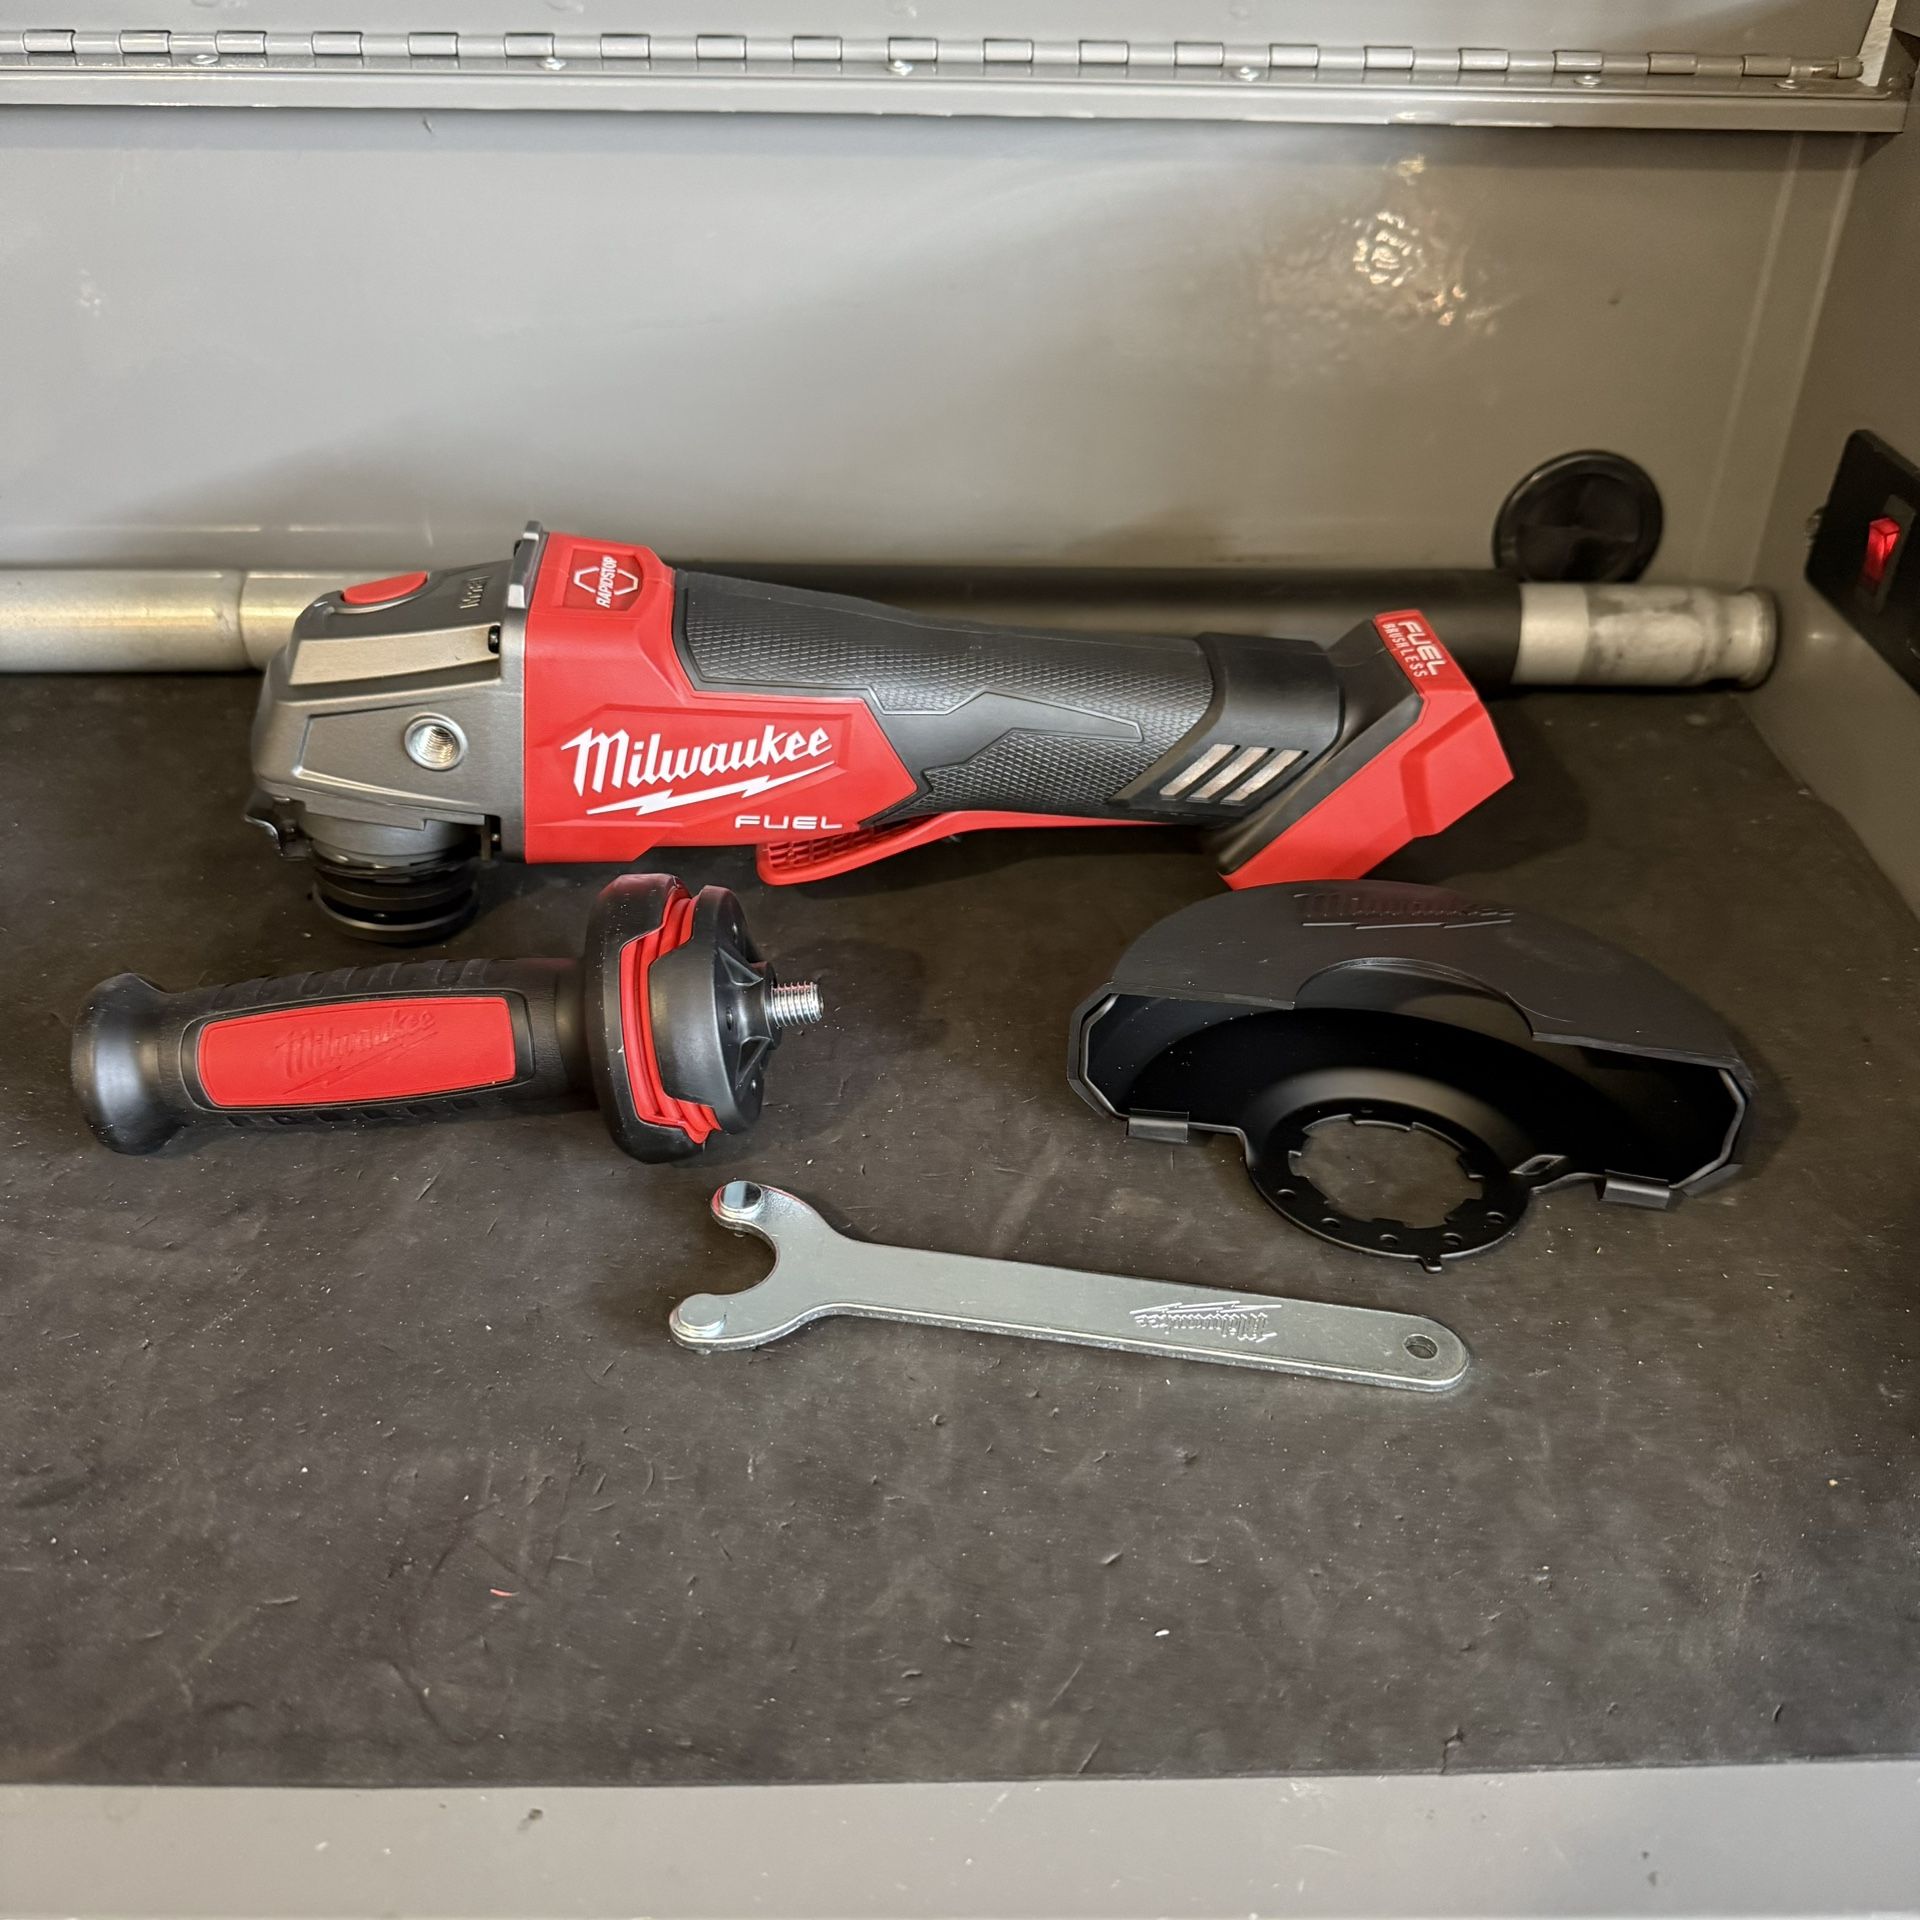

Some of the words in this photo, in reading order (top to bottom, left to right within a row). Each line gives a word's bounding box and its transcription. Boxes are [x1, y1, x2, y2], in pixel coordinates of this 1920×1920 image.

[595, 554, 618, 609] RAPIDSTOP
[1382, 623, 1428, 678] BRUSHLESS
[1398, 620, 1446, 676] FUEL
[560, 725, 834, 797] Milwaukee
[734, 815, 843, 830] FUEL
[275, 1009, 437, 1079] Milwaukee
